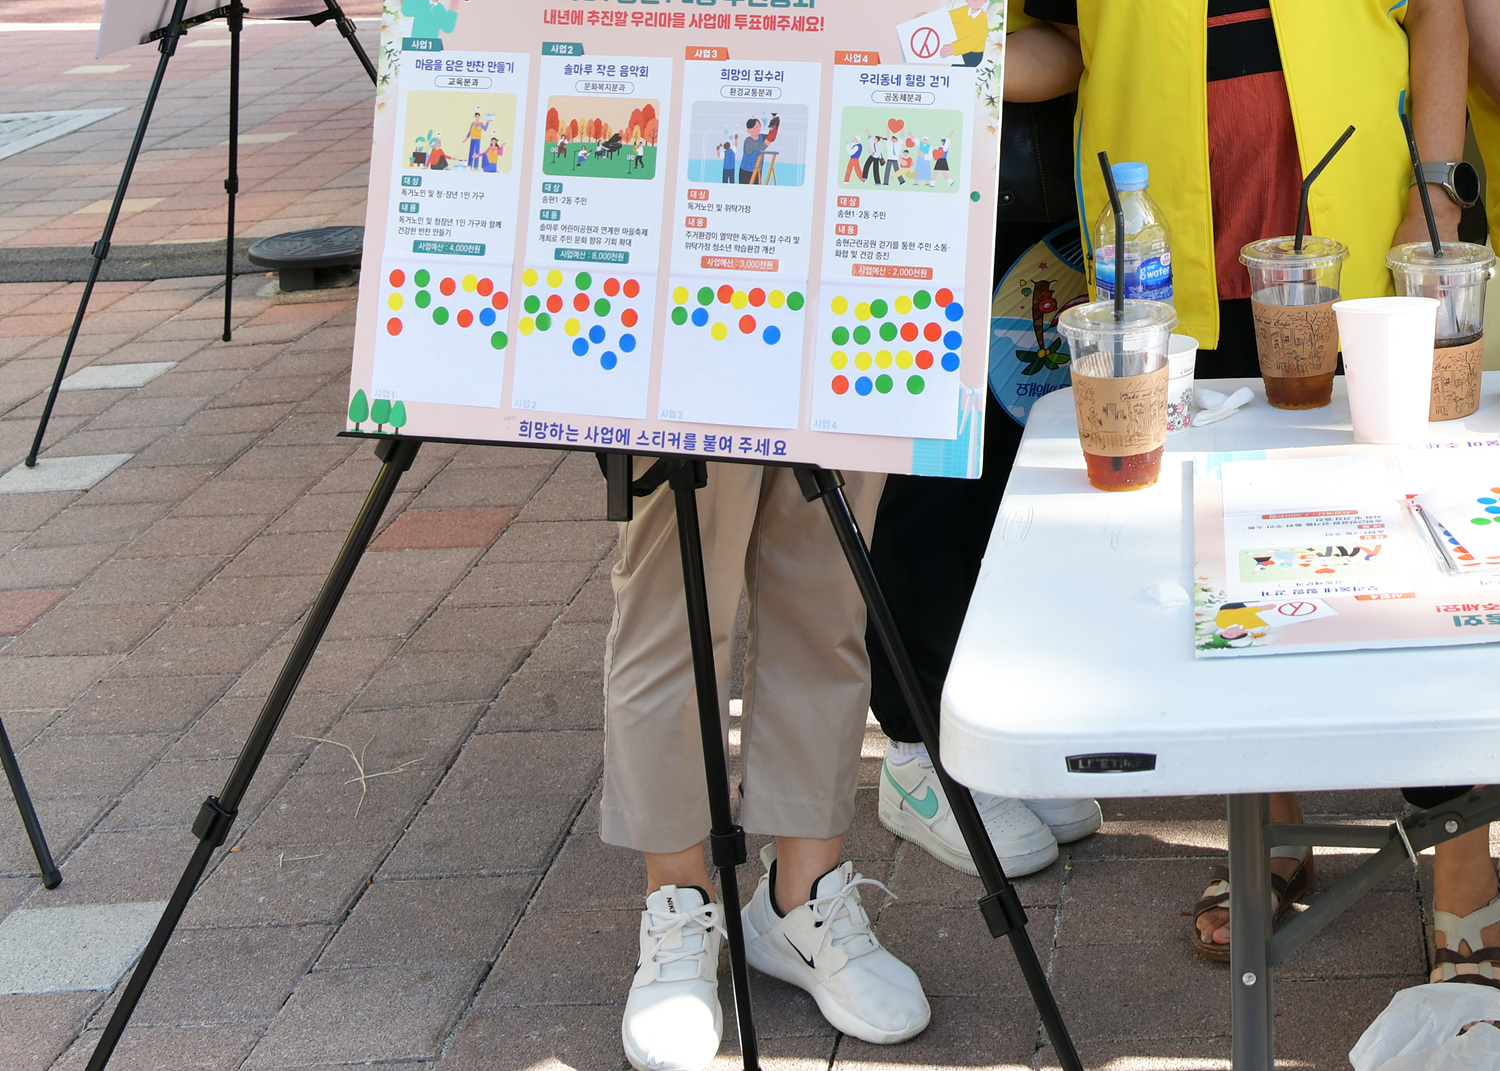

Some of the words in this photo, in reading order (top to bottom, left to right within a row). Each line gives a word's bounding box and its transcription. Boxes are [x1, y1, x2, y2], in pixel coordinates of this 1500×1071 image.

[544, 9, 583, 25] 내년에
[587, 11, 628, 27] 추진할
[631, 12, 685, 28] 우리마을
[689, 13, 731, 29] 사업에
[735, 15, 824, 31] 투표해주세요!
[416, 59, 442, 71] 마음을
[446, 60, 463, 71] 담은
[467, 61, 484, 72] 반찬
[488, 61, 514, 73] 만들기
[564, 64, 592, 75] 솔마루
[596, 65, 616, 76] 작은
[620, 65, 649, 77] 음악회
[720, 68, 750, 81] 희망의
[754, 70, 784, 82] 집수리
[859, 73, 901, 86] 우리동네
[906, 74, 925, 87] 힐링
[930, 75, 949, 88] 걷기
[448, 78, 479, 86] 교육분과
[584, 83, 625, 92] 문화복지분과
[730, 88, 772, 97] 환경교통분과
[885, 93, 921, 102] 공동체분과
[401, 189, 426, 197] 독거노인
[472, 192, 484, 200] 가구
[574, 197, 587, 205] 주민
[688, 202, 713, 211] 독거노인
[716, 204, 722, 212] 및
[725, 204, 751, 213] 위탁가정
[873, 211, 886, 220] 주민
[399, 216, 423, 224] 독거노인
[435, 218, 453, 226] 청장년
[456, 219, 465, 227] 1인
[468, 219, 487, 228] 가구와
[398, 227, 416, 235] 건강한
[418, 228, 430, 236] 반찬
[433, 229, 451, 237] 만들기
[540, 223, 558, 232] 솔마루
[561, 224, 599, 234] 어린이공원과
[601, 226, 620, 234] 연계한
[622, 227, 648, 236] 마을축제
[575, 236, 587, 244] 문화
[590, 237, 602, 245] 향유
[619, 238, 632, 246] 확대
[685, 231, 717, 240] 주거환경이
[720, 232, 739, 241] 열악한
[741, 233, 767, 242] 독거노인
[793, 236, 800, 244] 및
[418, 243, 444, 251] 사업예산
[449, 244, 480, 253] 4,000천원
[685, 242, 710, 251] 위탁가정
[713, 243, 732, 252] 청소년
[734, 244, 760, 254] 학습환경
[762, 246, 775, 254] 개선
[836, 239, 876, 248] 송현근린공원
[879, 240, 898, 249] 걷기를
[902, 242, 915, 250] 통한
[918, 243, 931, 251] 주민
[560, 250, 586, 259] 사업예산
[592, 252, 624, 261] 8,000천원
[835, 250, 848, 258] 화합
[851, 251, 857, 259] 및
[860, 251, 873, 259] 건강
[876, 252, 889, 260] 증진
[707, 258, 733, 267] 사업예산
[740, 260, 773, 269] 3,000천원
[858, 267, 885, 275] 사업예산
[893, 268, 927, 277] 2,000천원
[519, 420, 579, 442] 희망하는
[584, 426, 630, 446] 사업에
[636, 430, 696, 451] 스티커를
[703, 434, 732, 453] 붙여
[739, 436, 786, 456] 주세요
